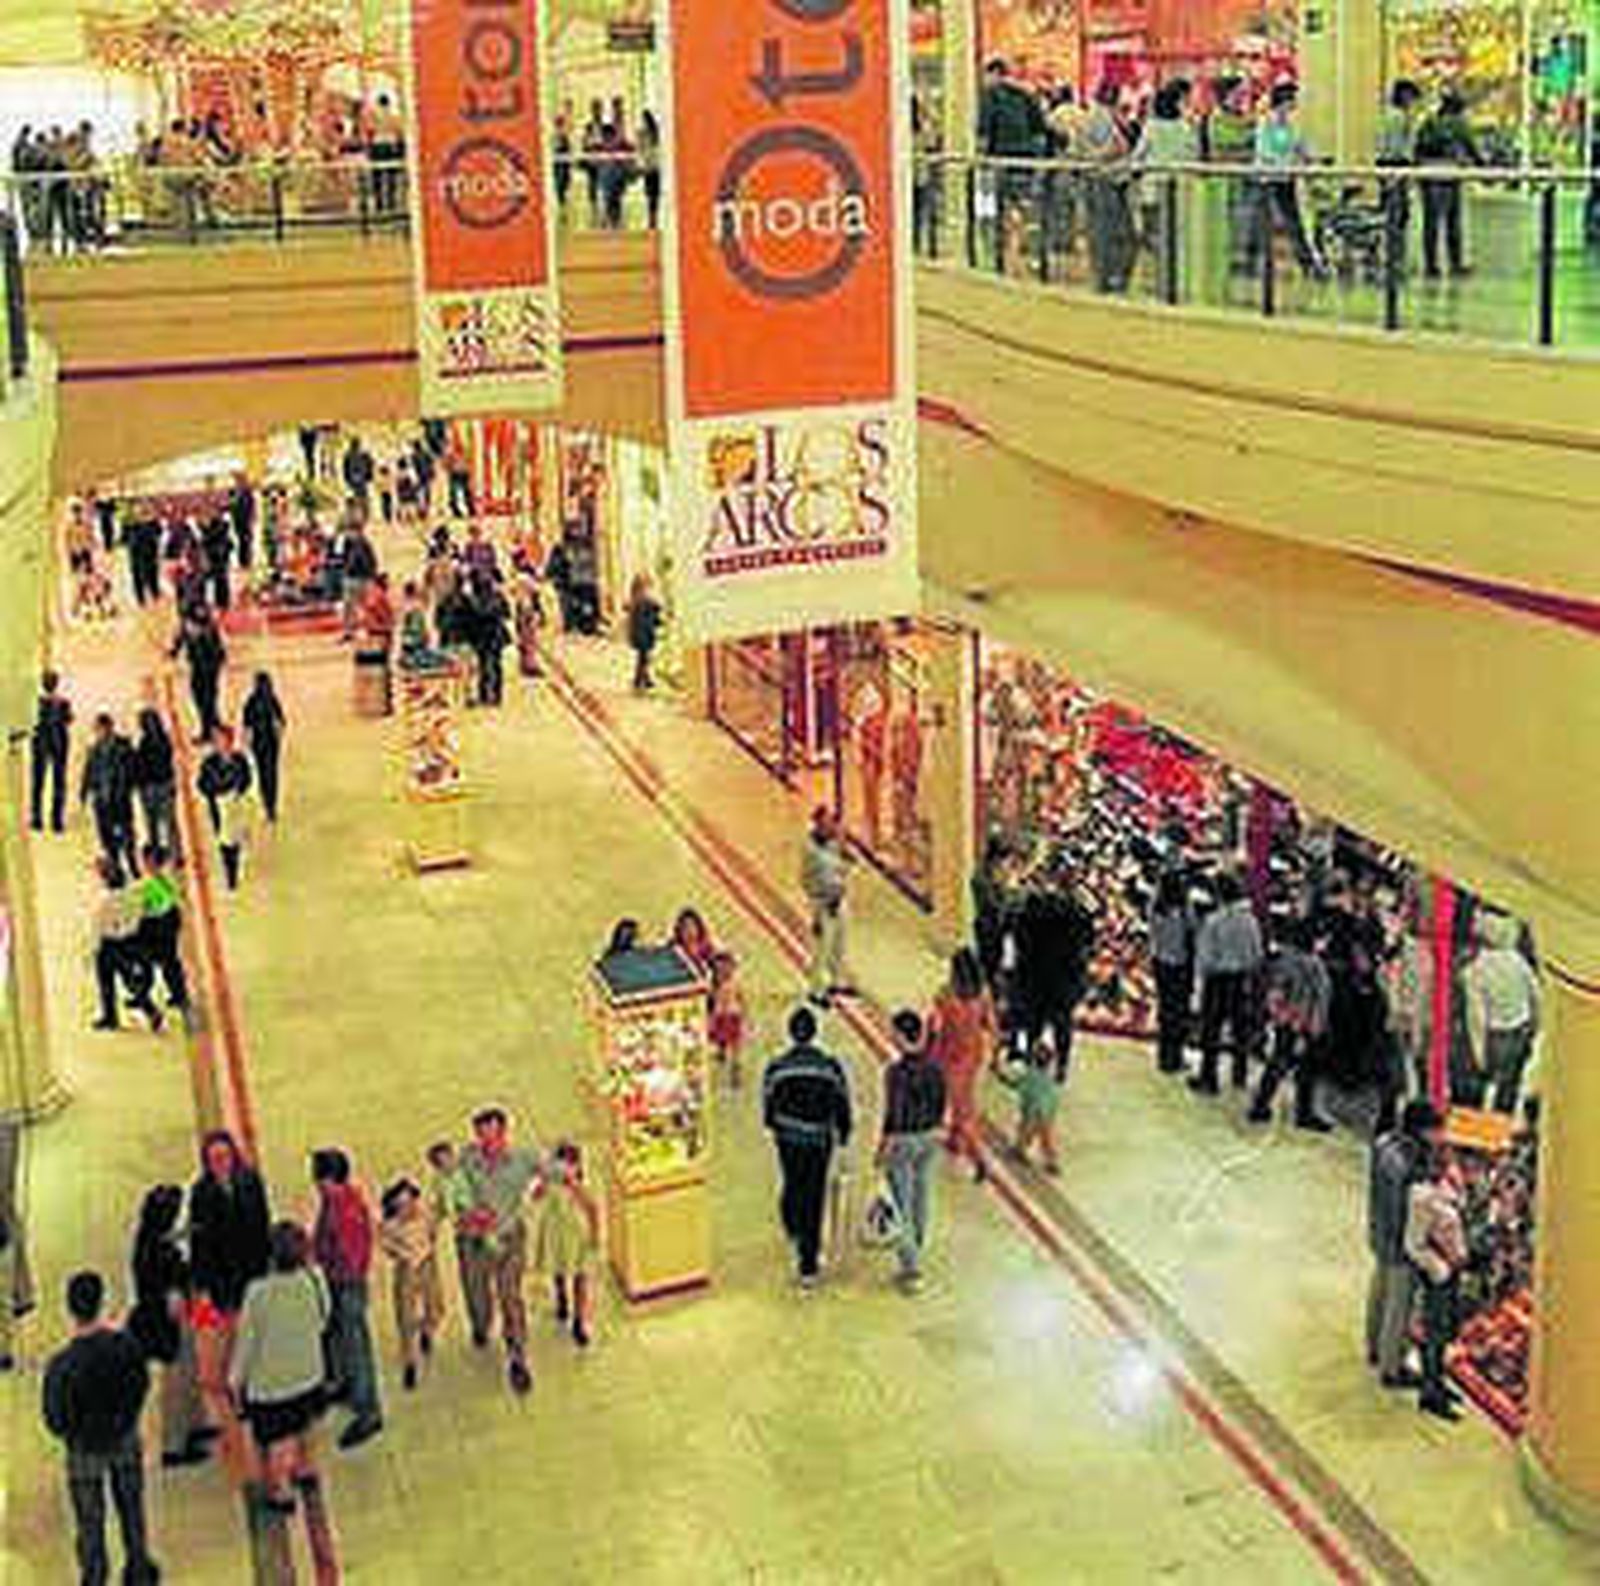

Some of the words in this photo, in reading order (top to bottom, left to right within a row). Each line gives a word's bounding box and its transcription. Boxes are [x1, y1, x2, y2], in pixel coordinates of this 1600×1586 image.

[437, 156, 529, 203] moda
[709, 174, 872, 243] moda
[703, 480, 891, 551] ARCOS
